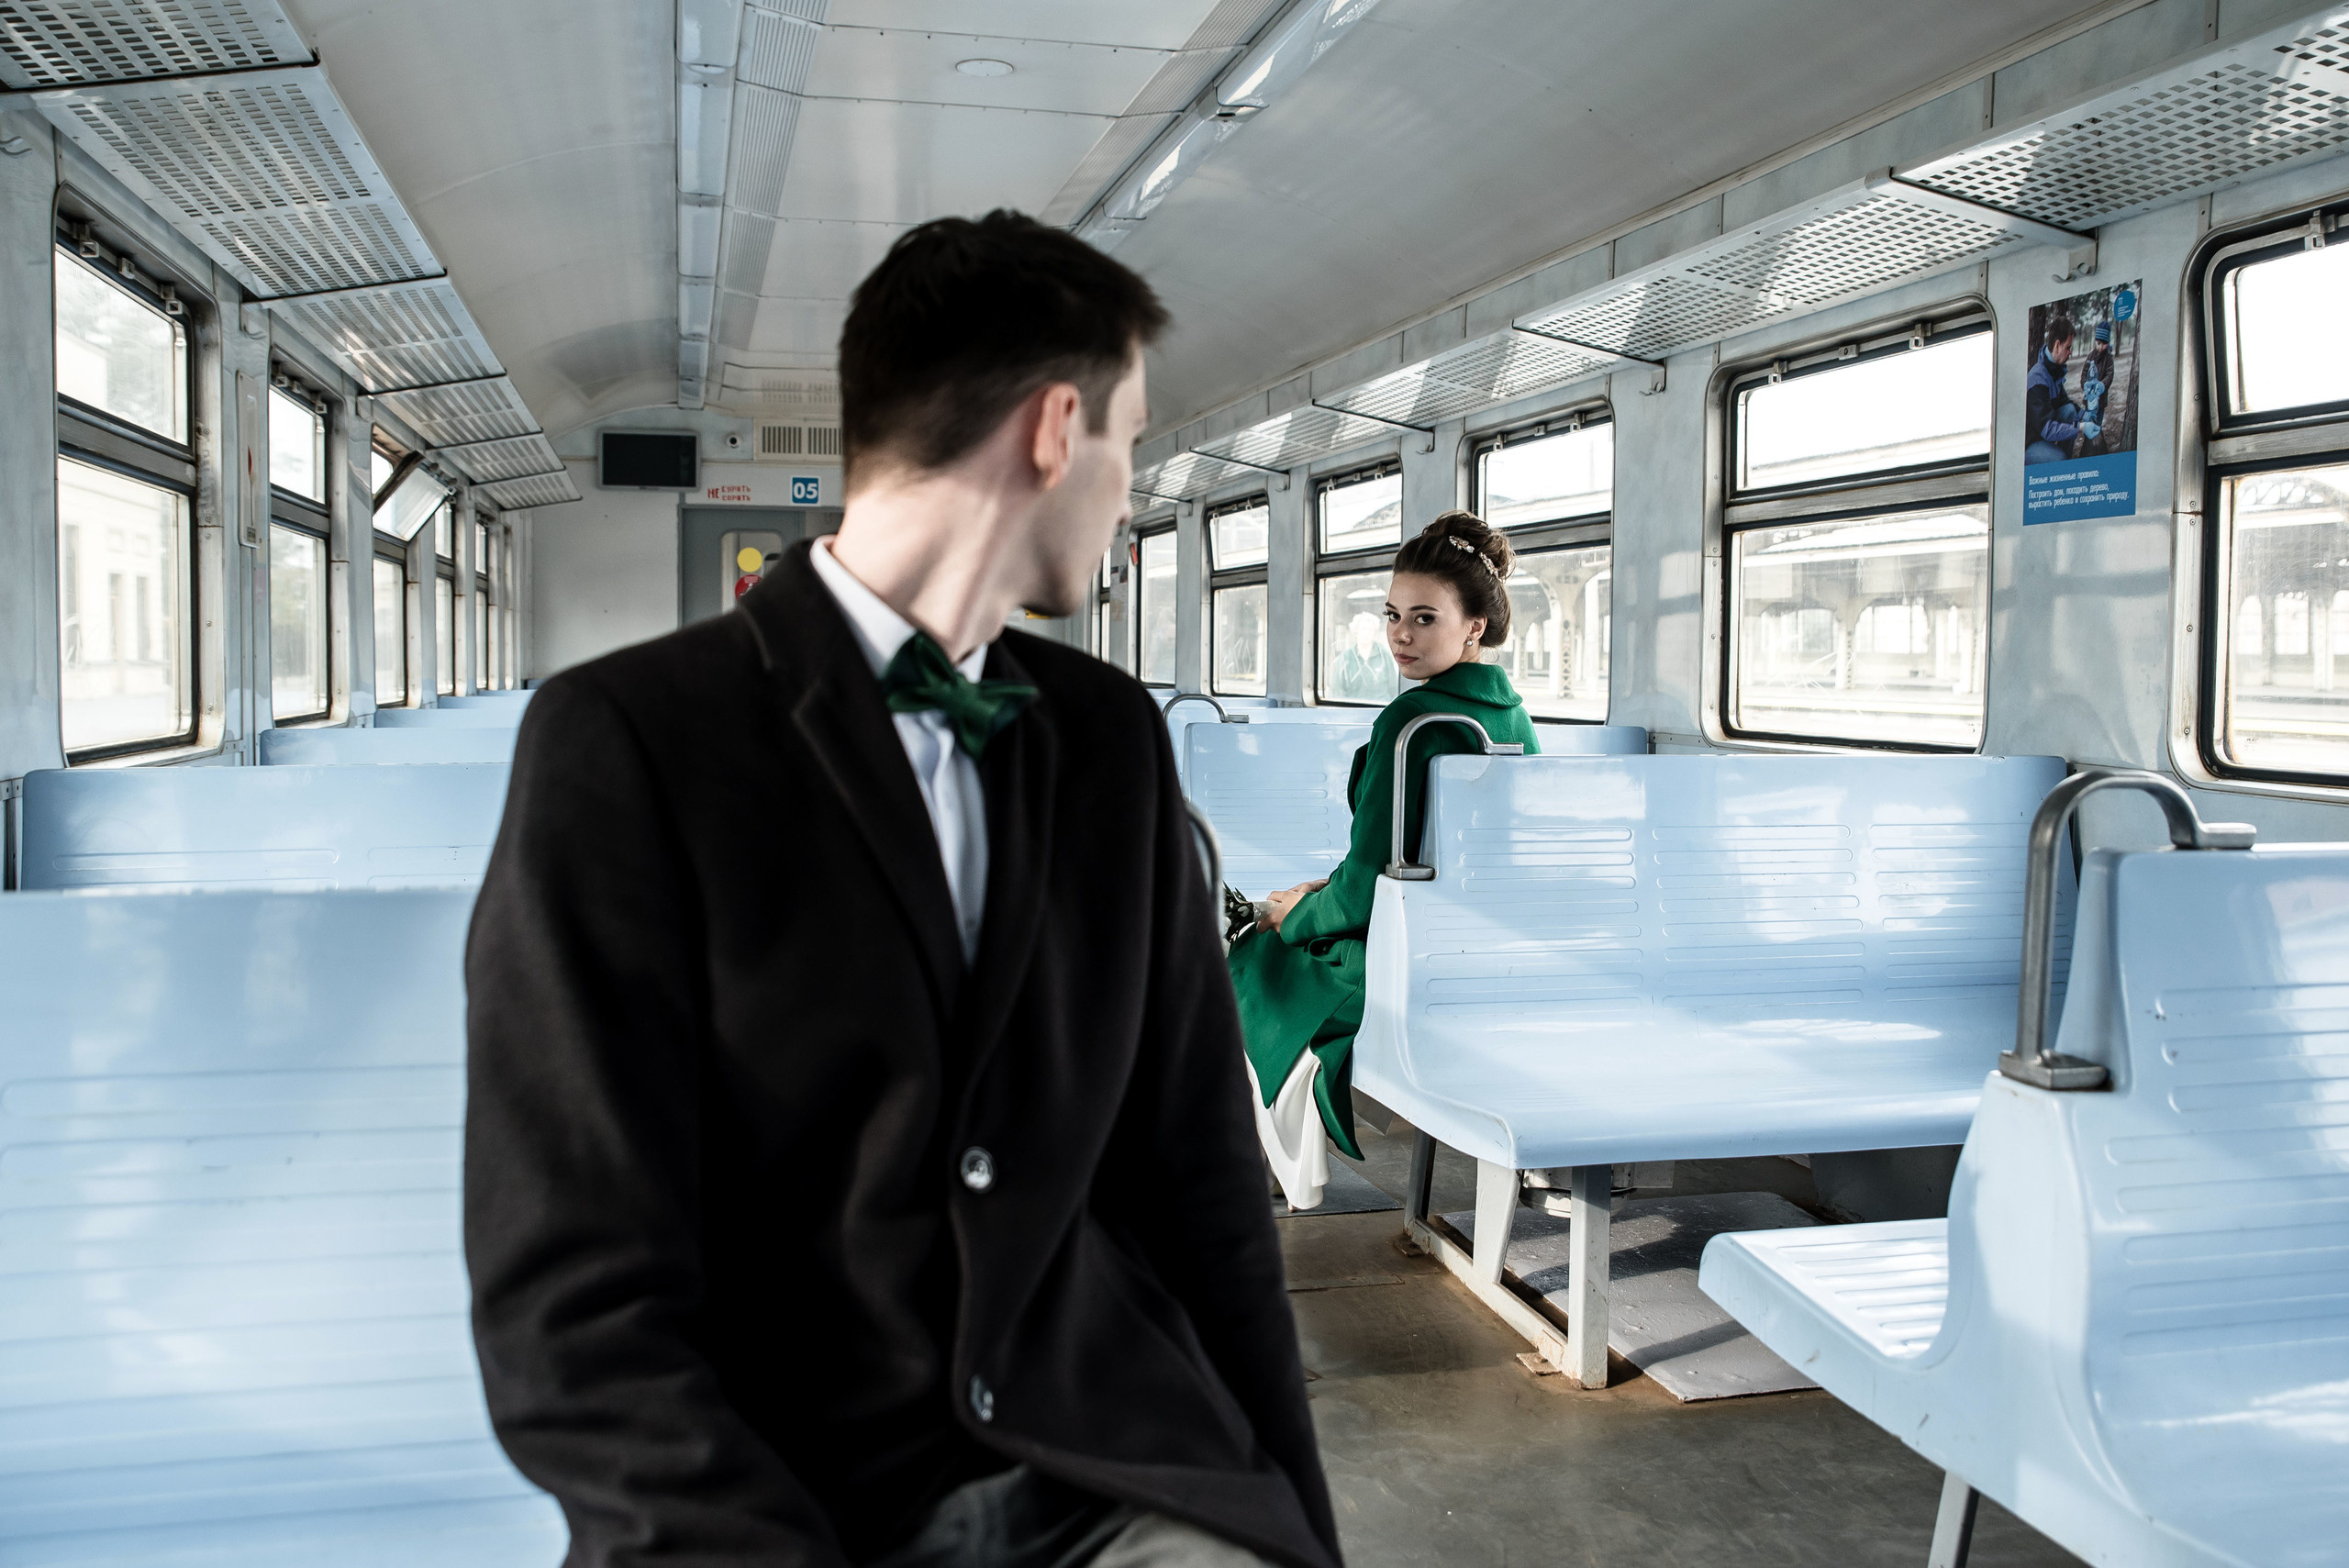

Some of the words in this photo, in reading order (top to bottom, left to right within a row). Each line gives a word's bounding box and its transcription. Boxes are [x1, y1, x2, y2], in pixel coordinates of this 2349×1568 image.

[2029, 475, 2048, 485] Важные
[2049, 473, 2076, 483] жизненные
[707, 487, 719, 498] НЕ
[794, 482, 818, 500] 05
[2028, 489, 2053, 501] Построить
[2054, 489, 2065, 497] дом,
[2089, 484, 2110, 495] дерево,
[2054, 496, 2074, 508] ребенка
[2079, 494, 2105, 506] сохранить
